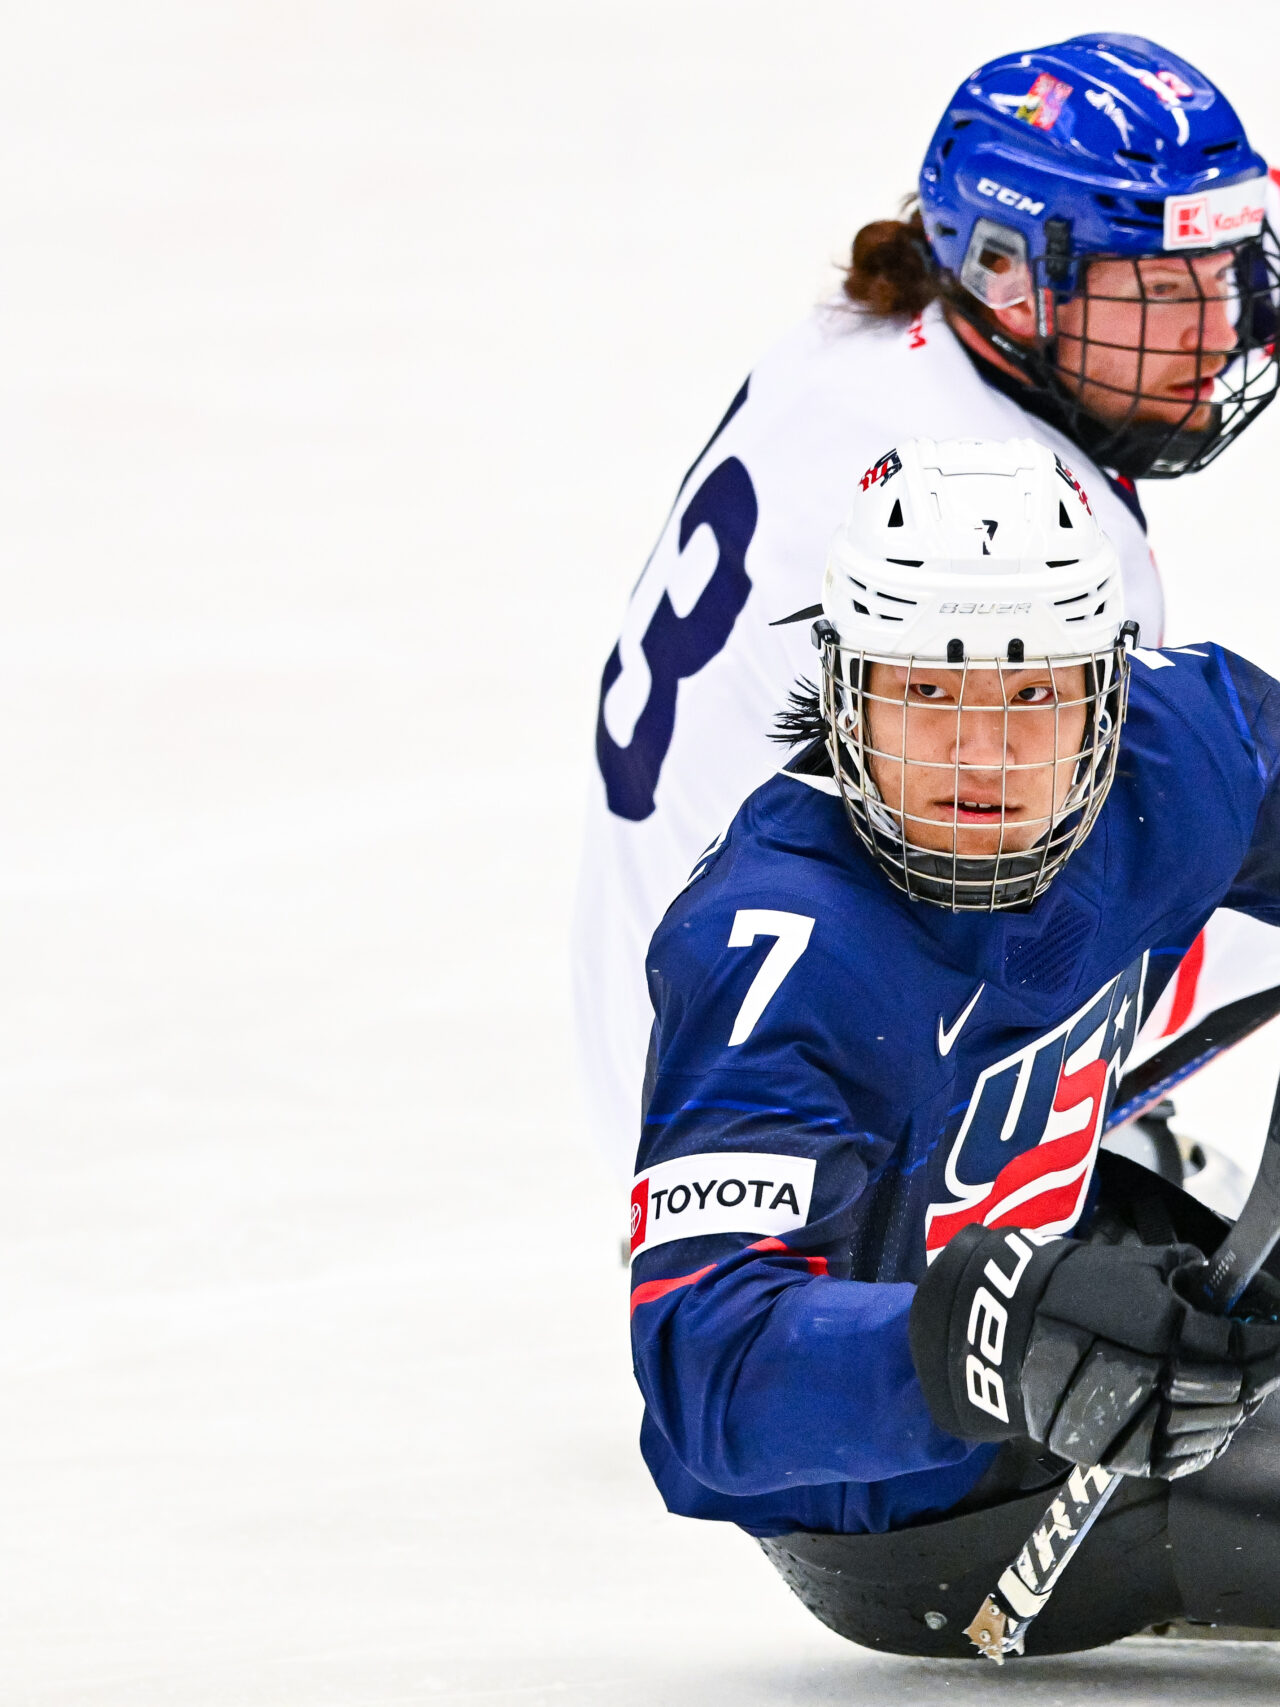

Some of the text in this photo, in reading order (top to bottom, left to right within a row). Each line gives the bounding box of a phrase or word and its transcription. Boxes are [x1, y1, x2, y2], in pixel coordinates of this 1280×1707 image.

[976, 176, 1046, 216] CCM
[976, 519, 999, 556] 7
[596, 370, 759, 822] 3
[939, 602, 1032, 615] BAUER
[728, 909, 815, 1047] 7
[651, 1178, 800, 1220] TOYOTA
